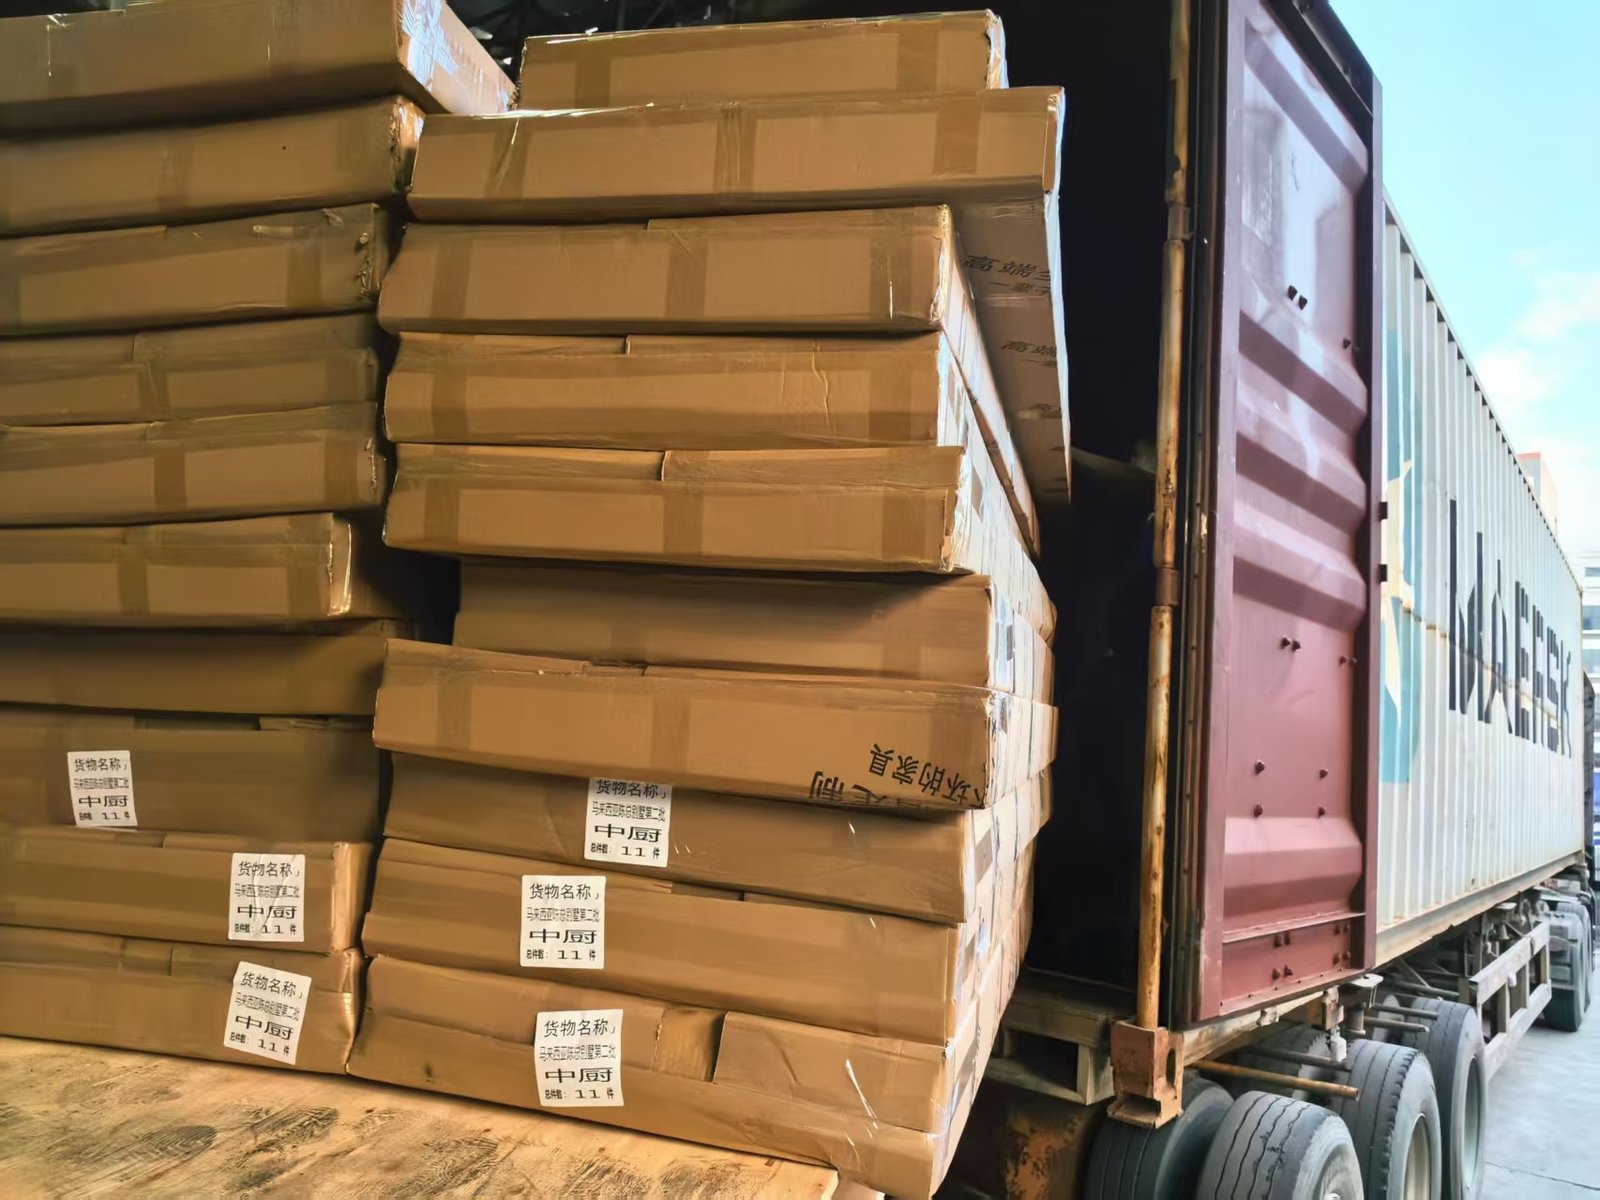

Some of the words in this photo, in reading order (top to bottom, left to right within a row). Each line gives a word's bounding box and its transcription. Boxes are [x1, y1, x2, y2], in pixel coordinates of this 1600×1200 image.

[79, 795, 128, 808] 中厨
[595, 823, 662, 843] 中厨
[237, 904, 297, 919] 中厨
[529, 928, 597, 944] 中厨
[235, 1015, 294, 1040] 中厨
[545, 1067, 613, 1083] 中厨
